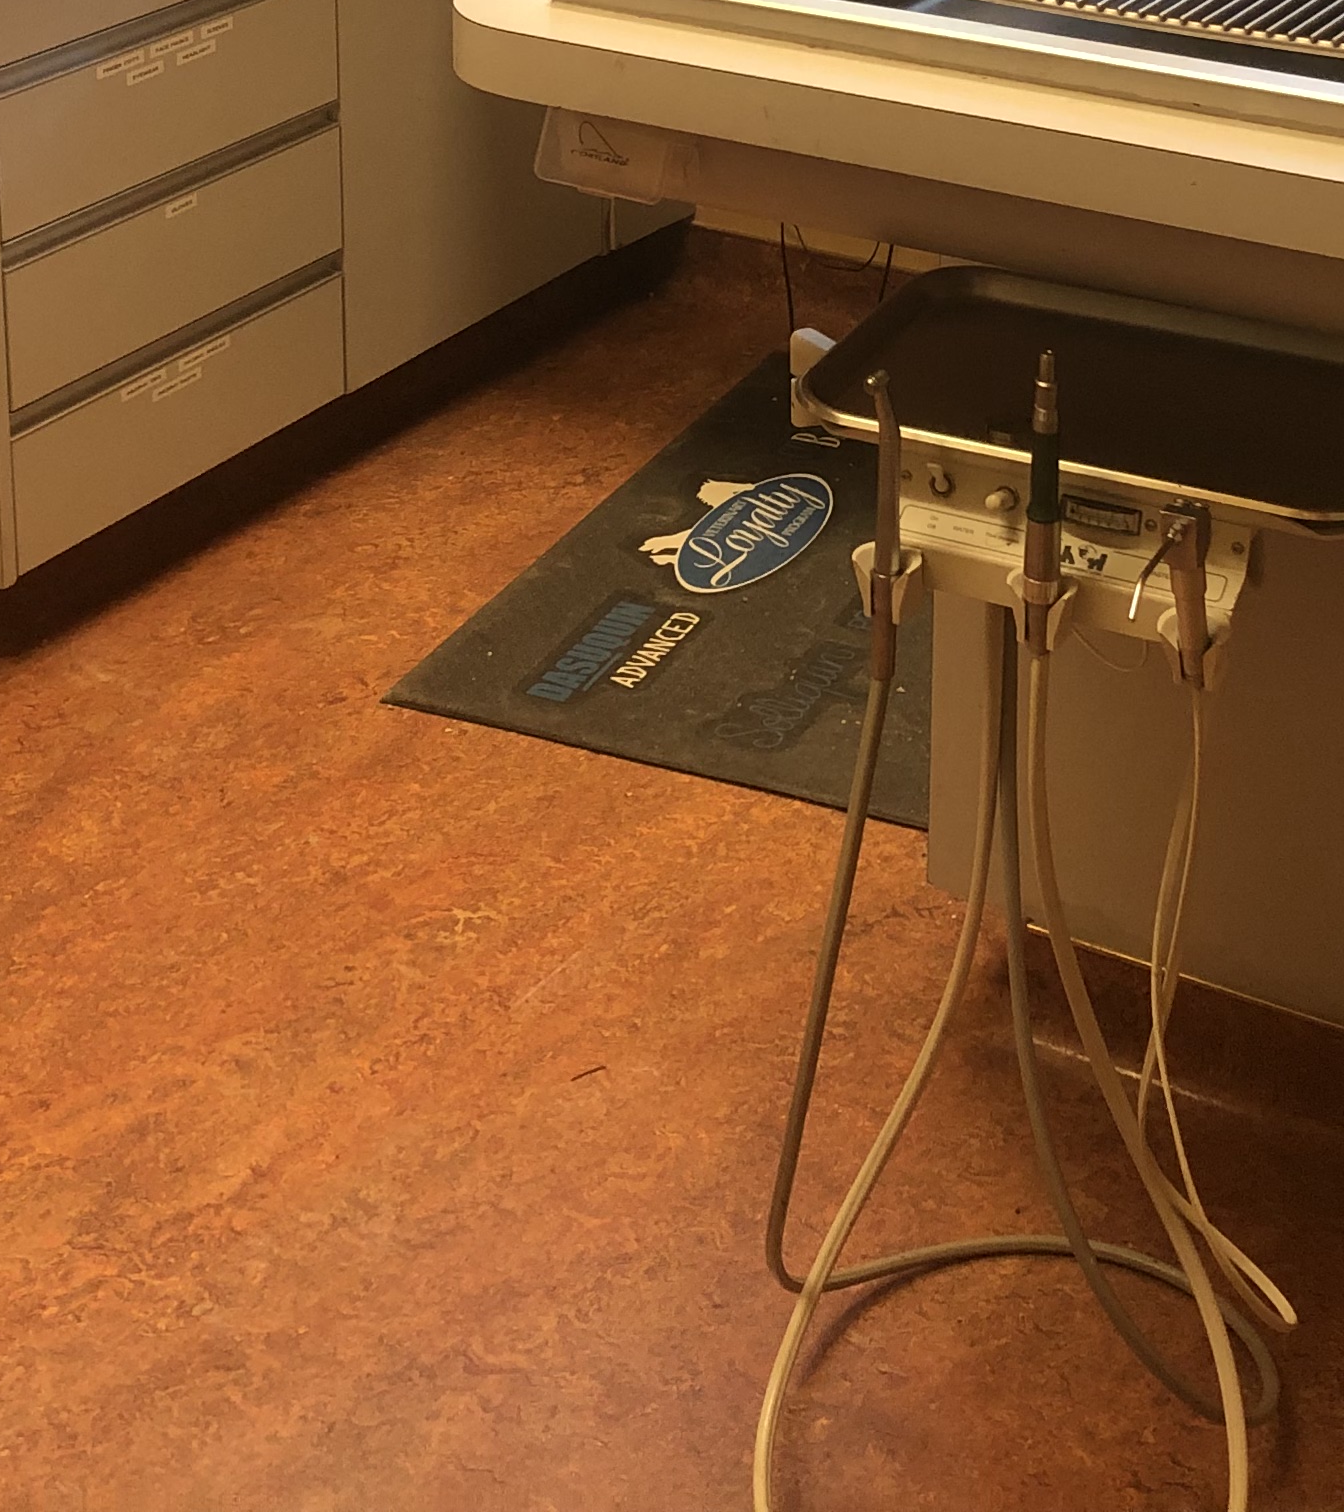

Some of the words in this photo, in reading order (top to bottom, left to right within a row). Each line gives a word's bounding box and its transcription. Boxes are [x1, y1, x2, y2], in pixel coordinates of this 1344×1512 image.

[693, 476, 827, 588] Loyalty
[525, 600, 657, 704] DASUQUIN
[609, 610, 702, 690] ADVANCED
